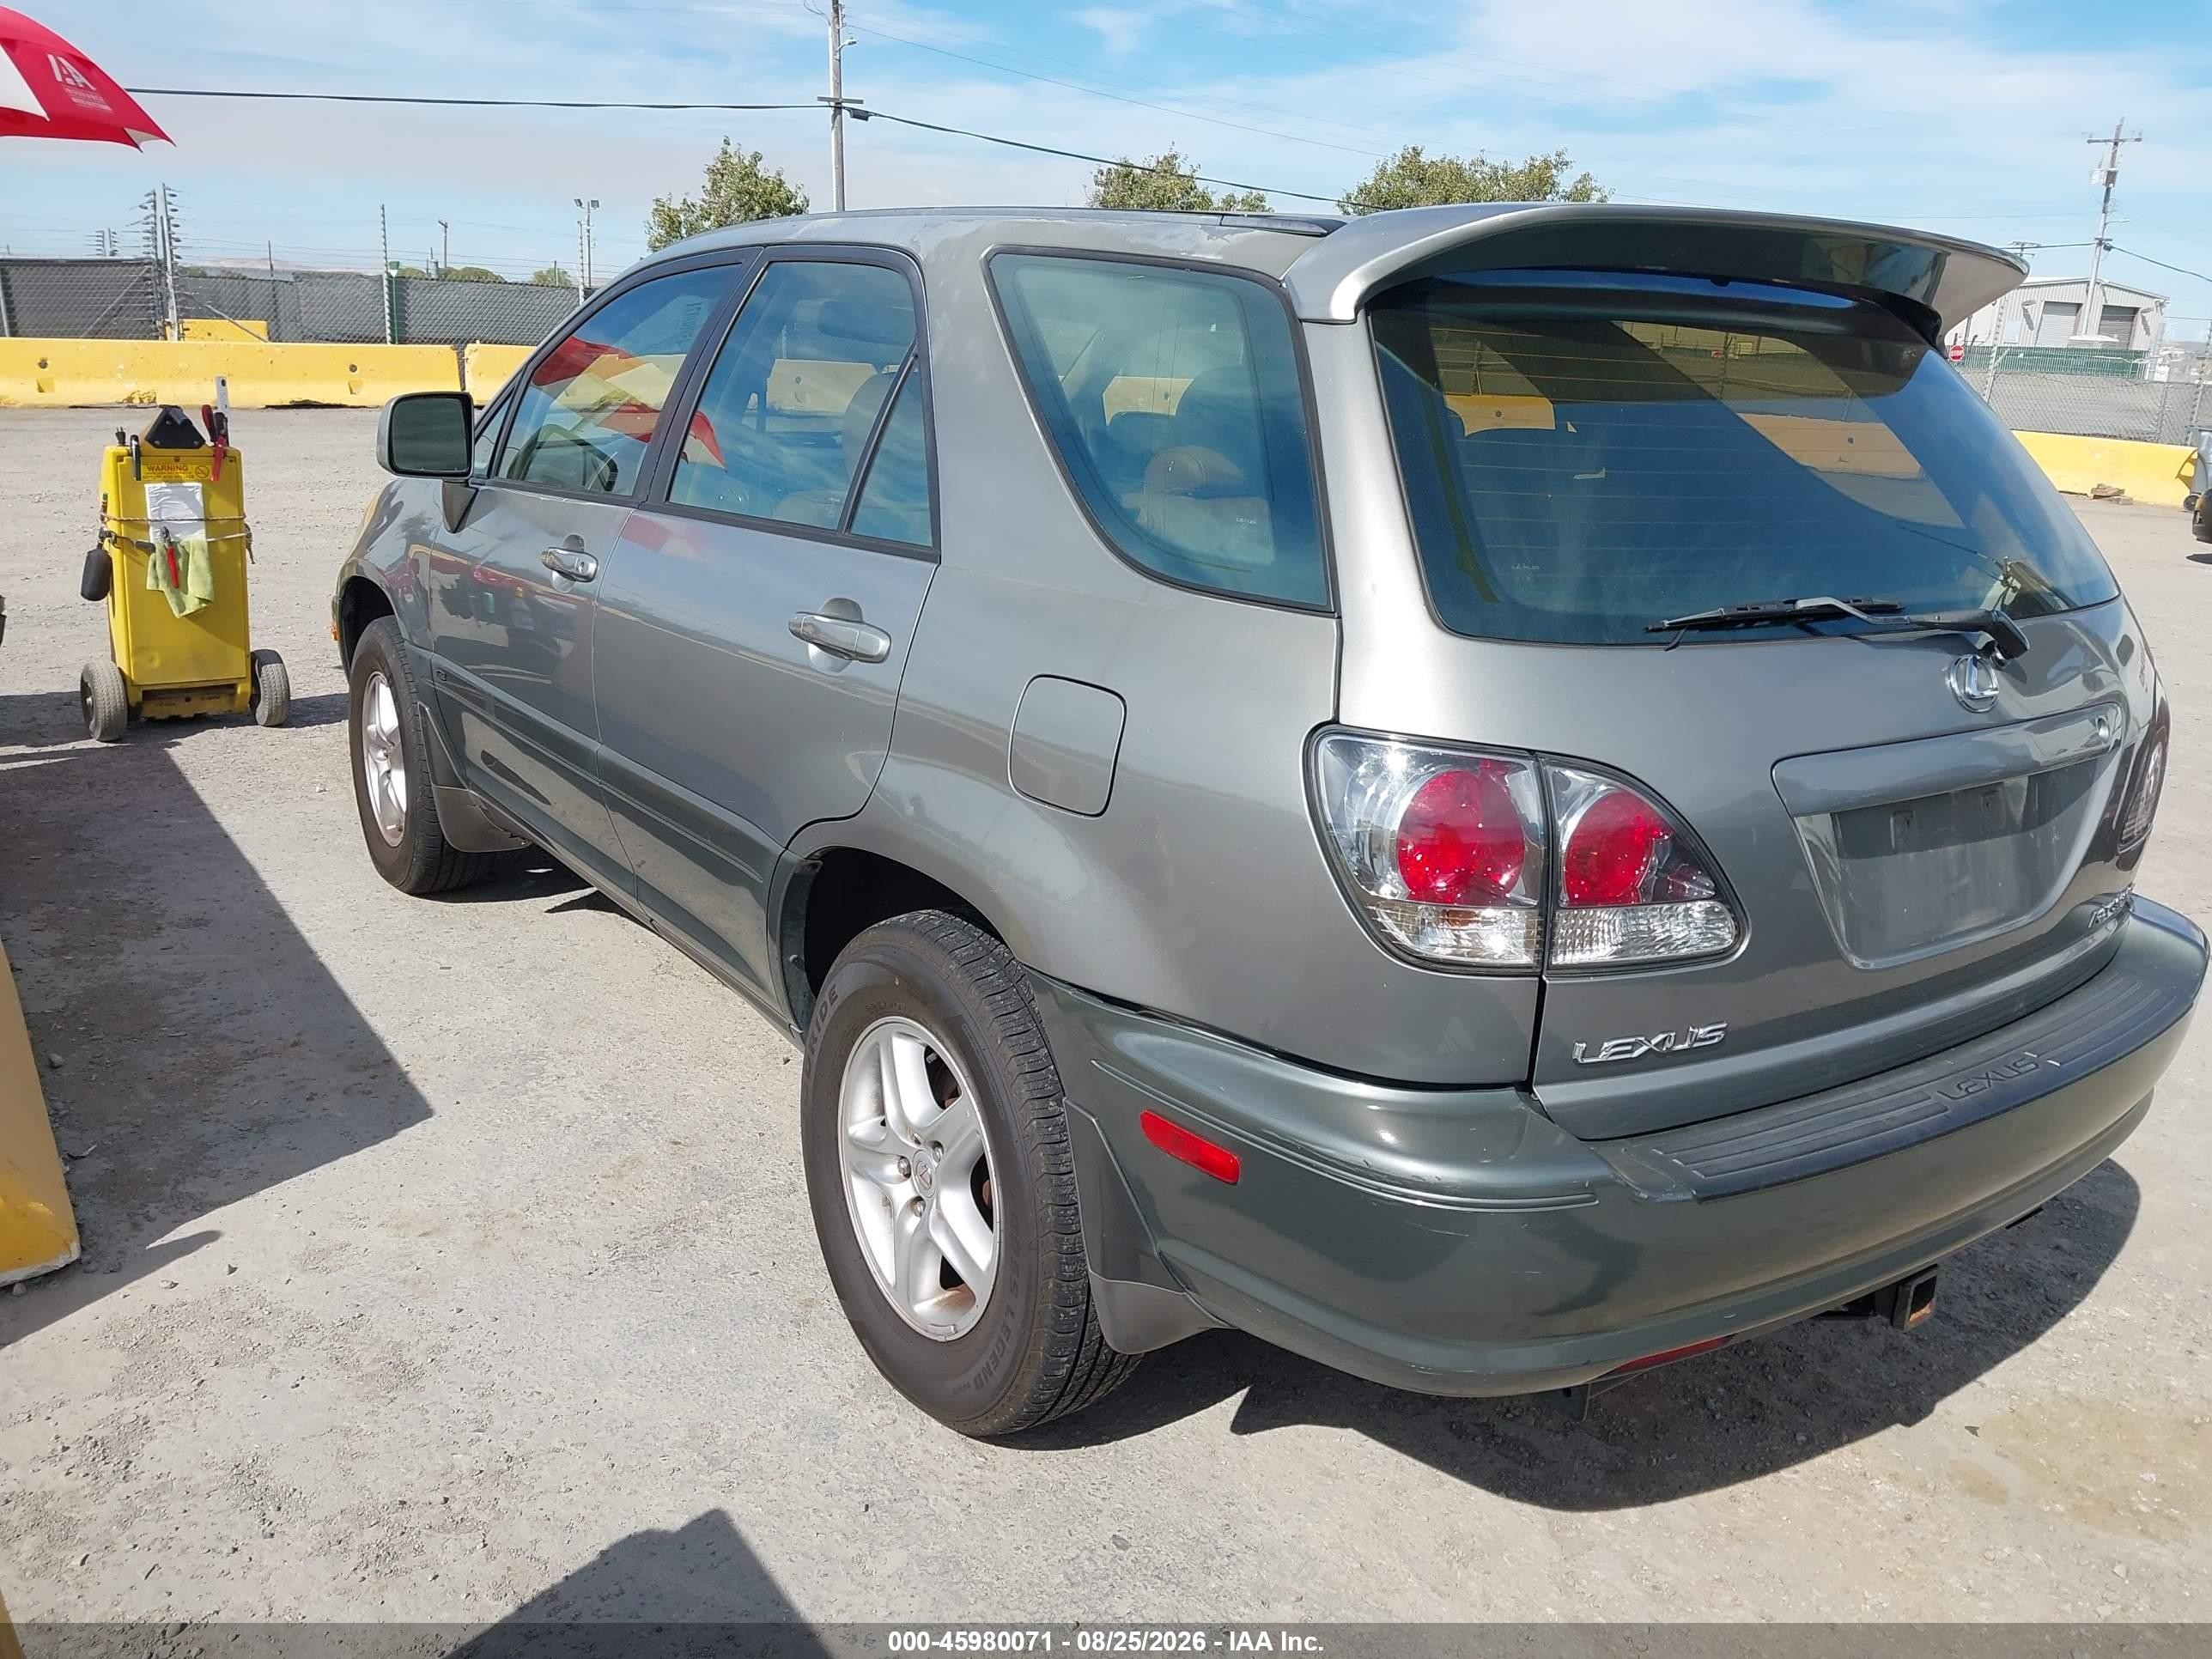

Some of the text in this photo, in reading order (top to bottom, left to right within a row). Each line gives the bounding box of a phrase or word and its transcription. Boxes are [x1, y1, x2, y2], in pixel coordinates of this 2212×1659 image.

[1572, 1021, 1729, 1065] LEXUS
[1936, 1057, 2040, 1100] LEXUS
[973, 1304, 1016, 1391] LEGEND
